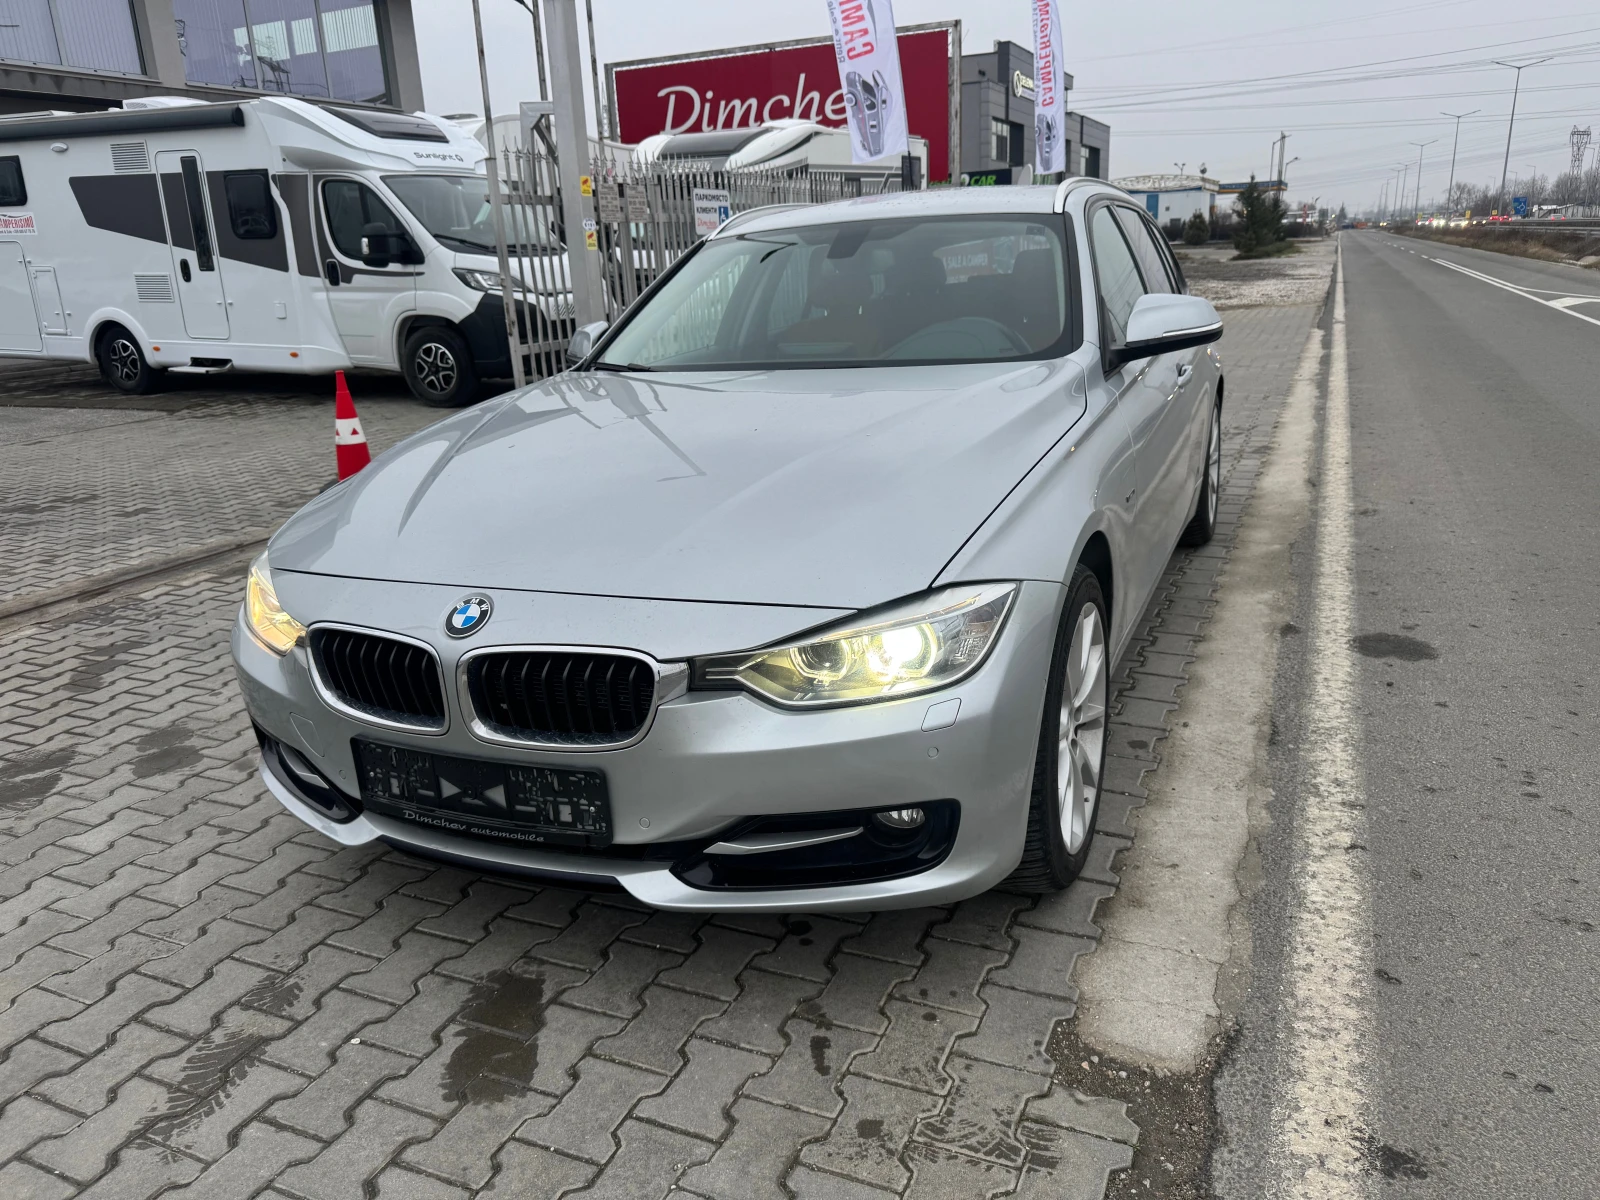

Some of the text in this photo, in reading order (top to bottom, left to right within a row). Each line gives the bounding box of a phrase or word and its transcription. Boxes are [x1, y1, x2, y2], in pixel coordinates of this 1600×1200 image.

[657, 73, 848, 135] Dimche
[413, 152, 456, 161] Sunlight
[970, 175, 997, 186] CAR
[695, 193, 728, 202] ПАРКОМЯСТО
[696, 206, 717, 214] КЛИЕНТИ
[0, 215, 35, 229] AMPERISIMO
[402, 809, 545, 843] Dimchev automobile
